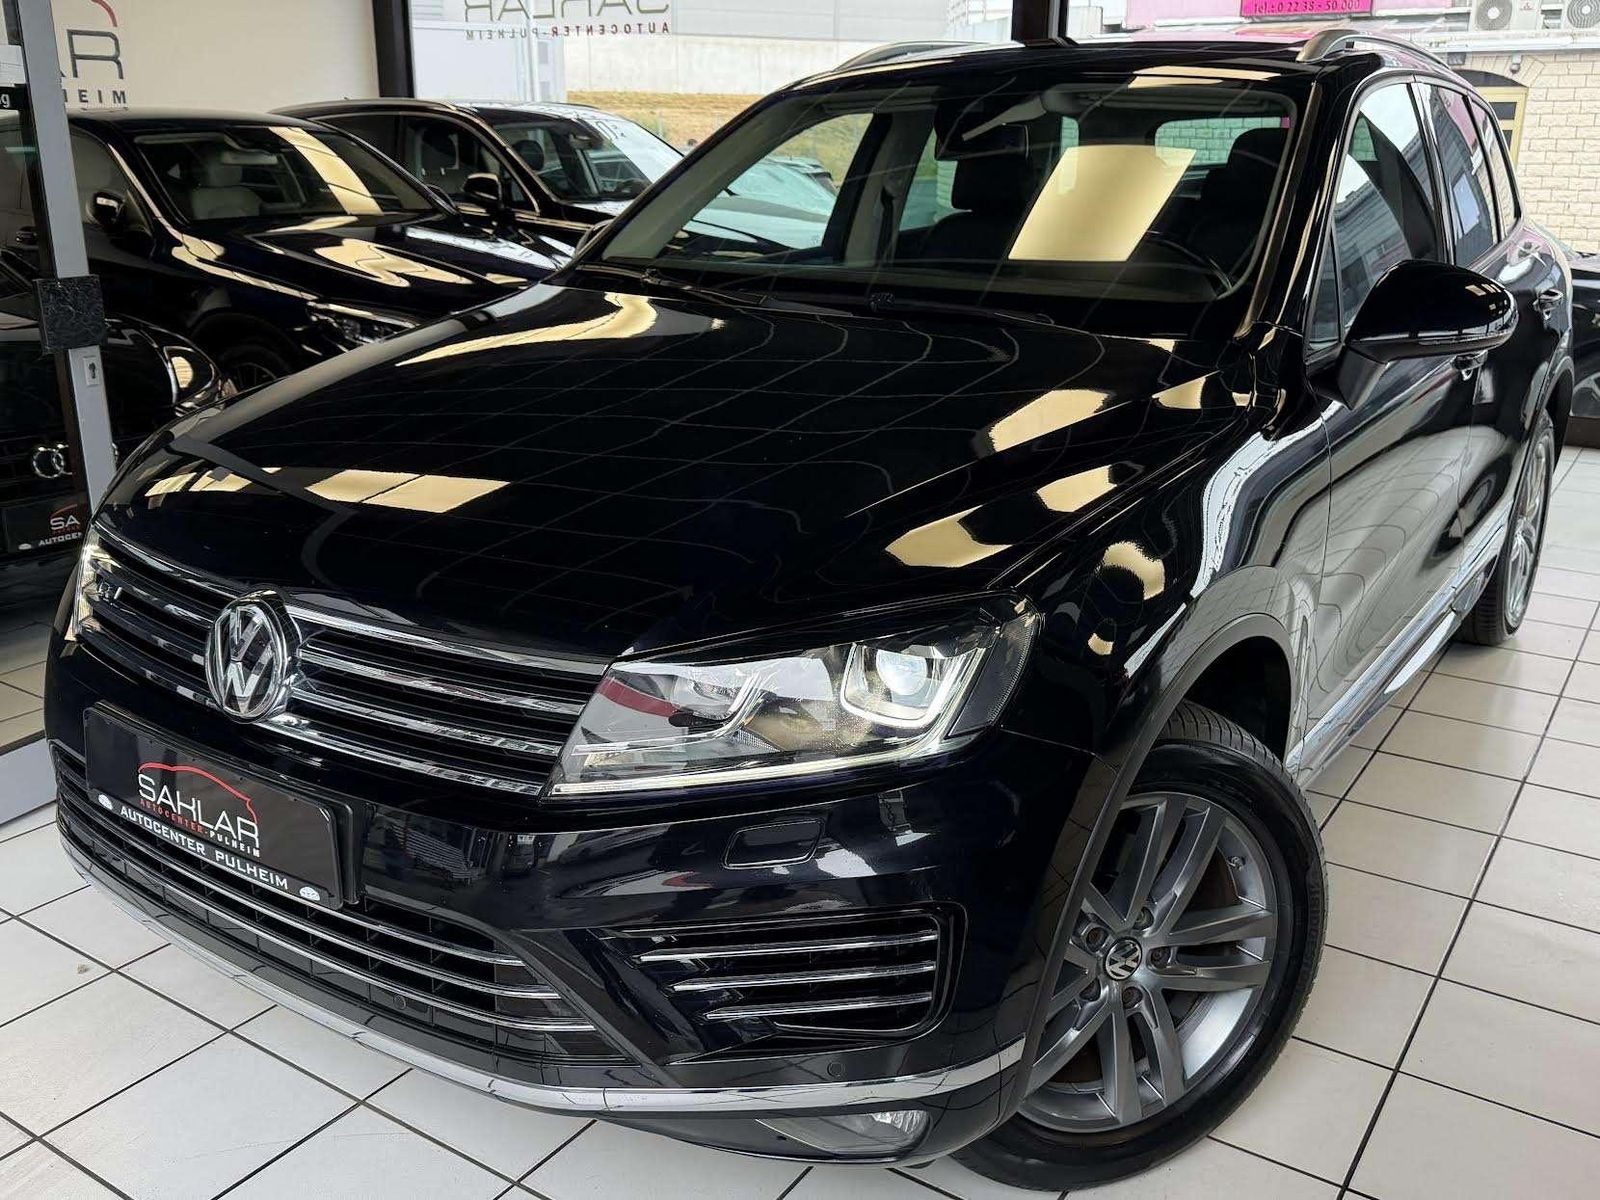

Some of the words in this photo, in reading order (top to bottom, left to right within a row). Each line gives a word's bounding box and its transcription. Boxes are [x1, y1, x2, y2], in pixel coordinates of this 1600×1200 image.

[120, 805, 206, 856] AUTOCENTER
[215, 849, 289, 890] PULHEIM
[138, 773, 260, 848] SAHLAR
